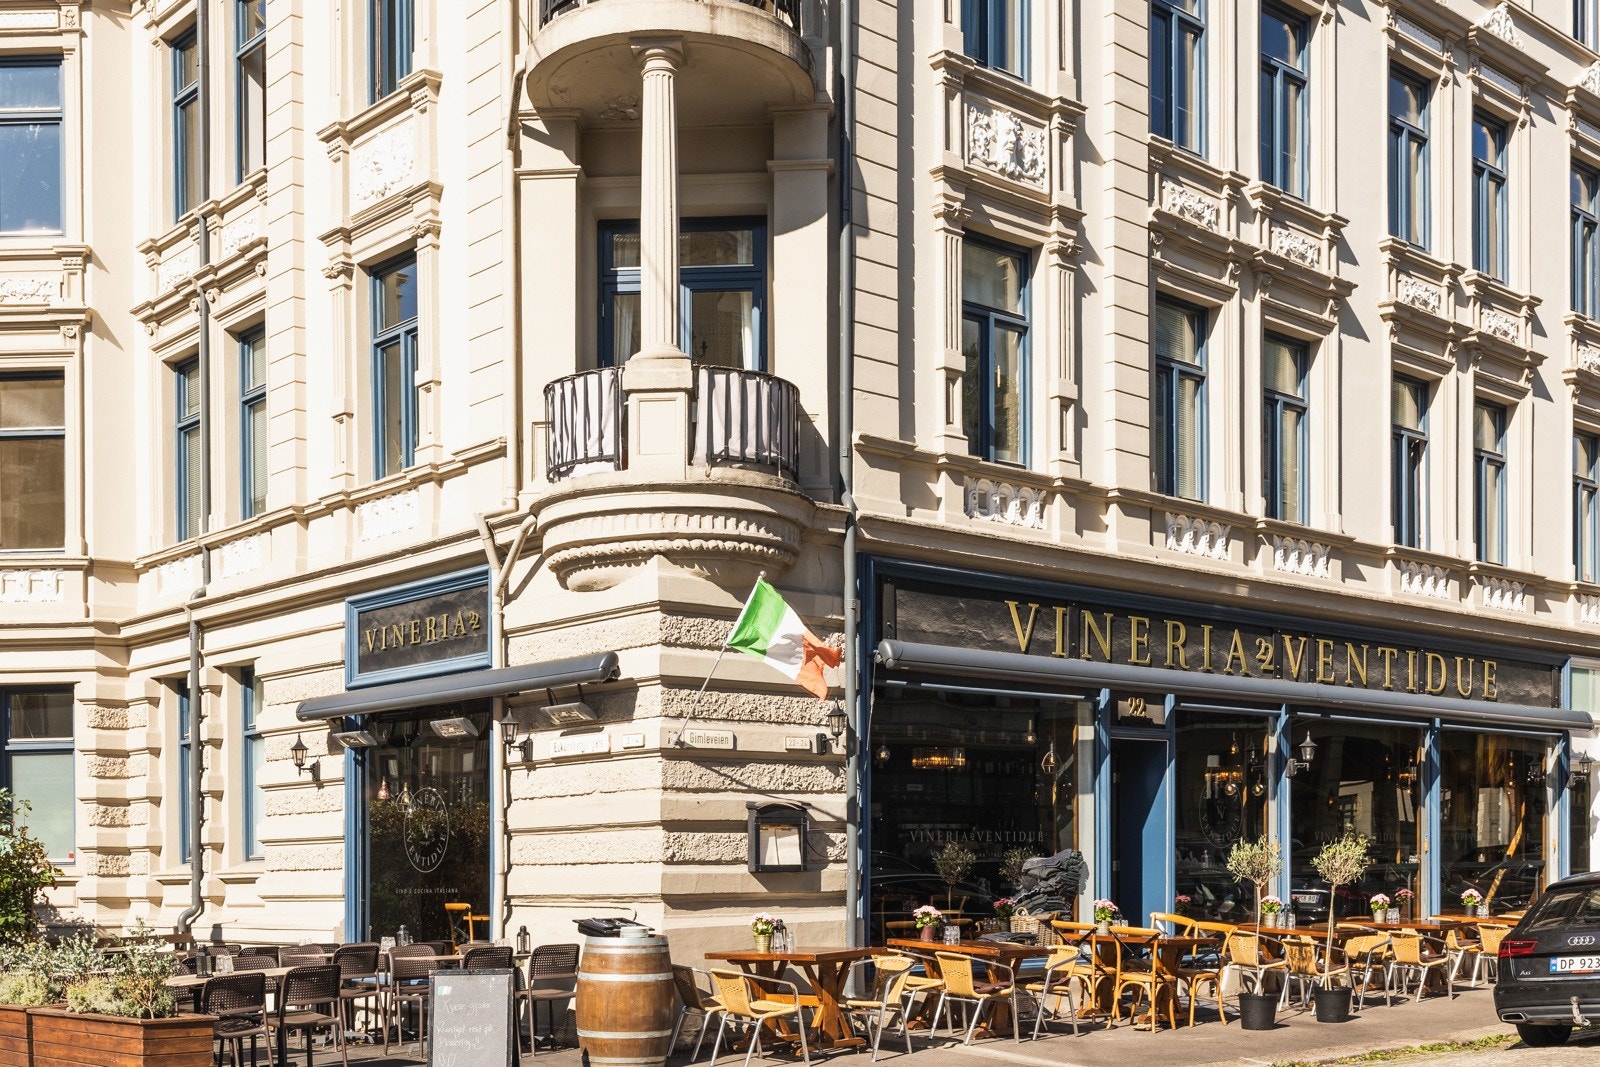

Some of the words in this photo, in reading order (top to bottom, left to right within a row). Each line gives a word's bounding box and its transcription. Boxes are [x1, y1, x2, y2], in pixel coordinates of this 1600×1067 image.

[365, 610, 467, 652] VINERIA
[1005, 600, 1251, 676] VINERIA
[1282, 634, 1498, 700] VENTIDUE
[1127, 696, 1147, 718] 22
[689, 732, 729, 745] Gimleveien
[910, 830, 968, 843] VINERIA
[976, 830, 1044, 843] VENTIDUE
[1560, 958, 1575, 970] DP
[1580, 957, 1600, 969] 923
